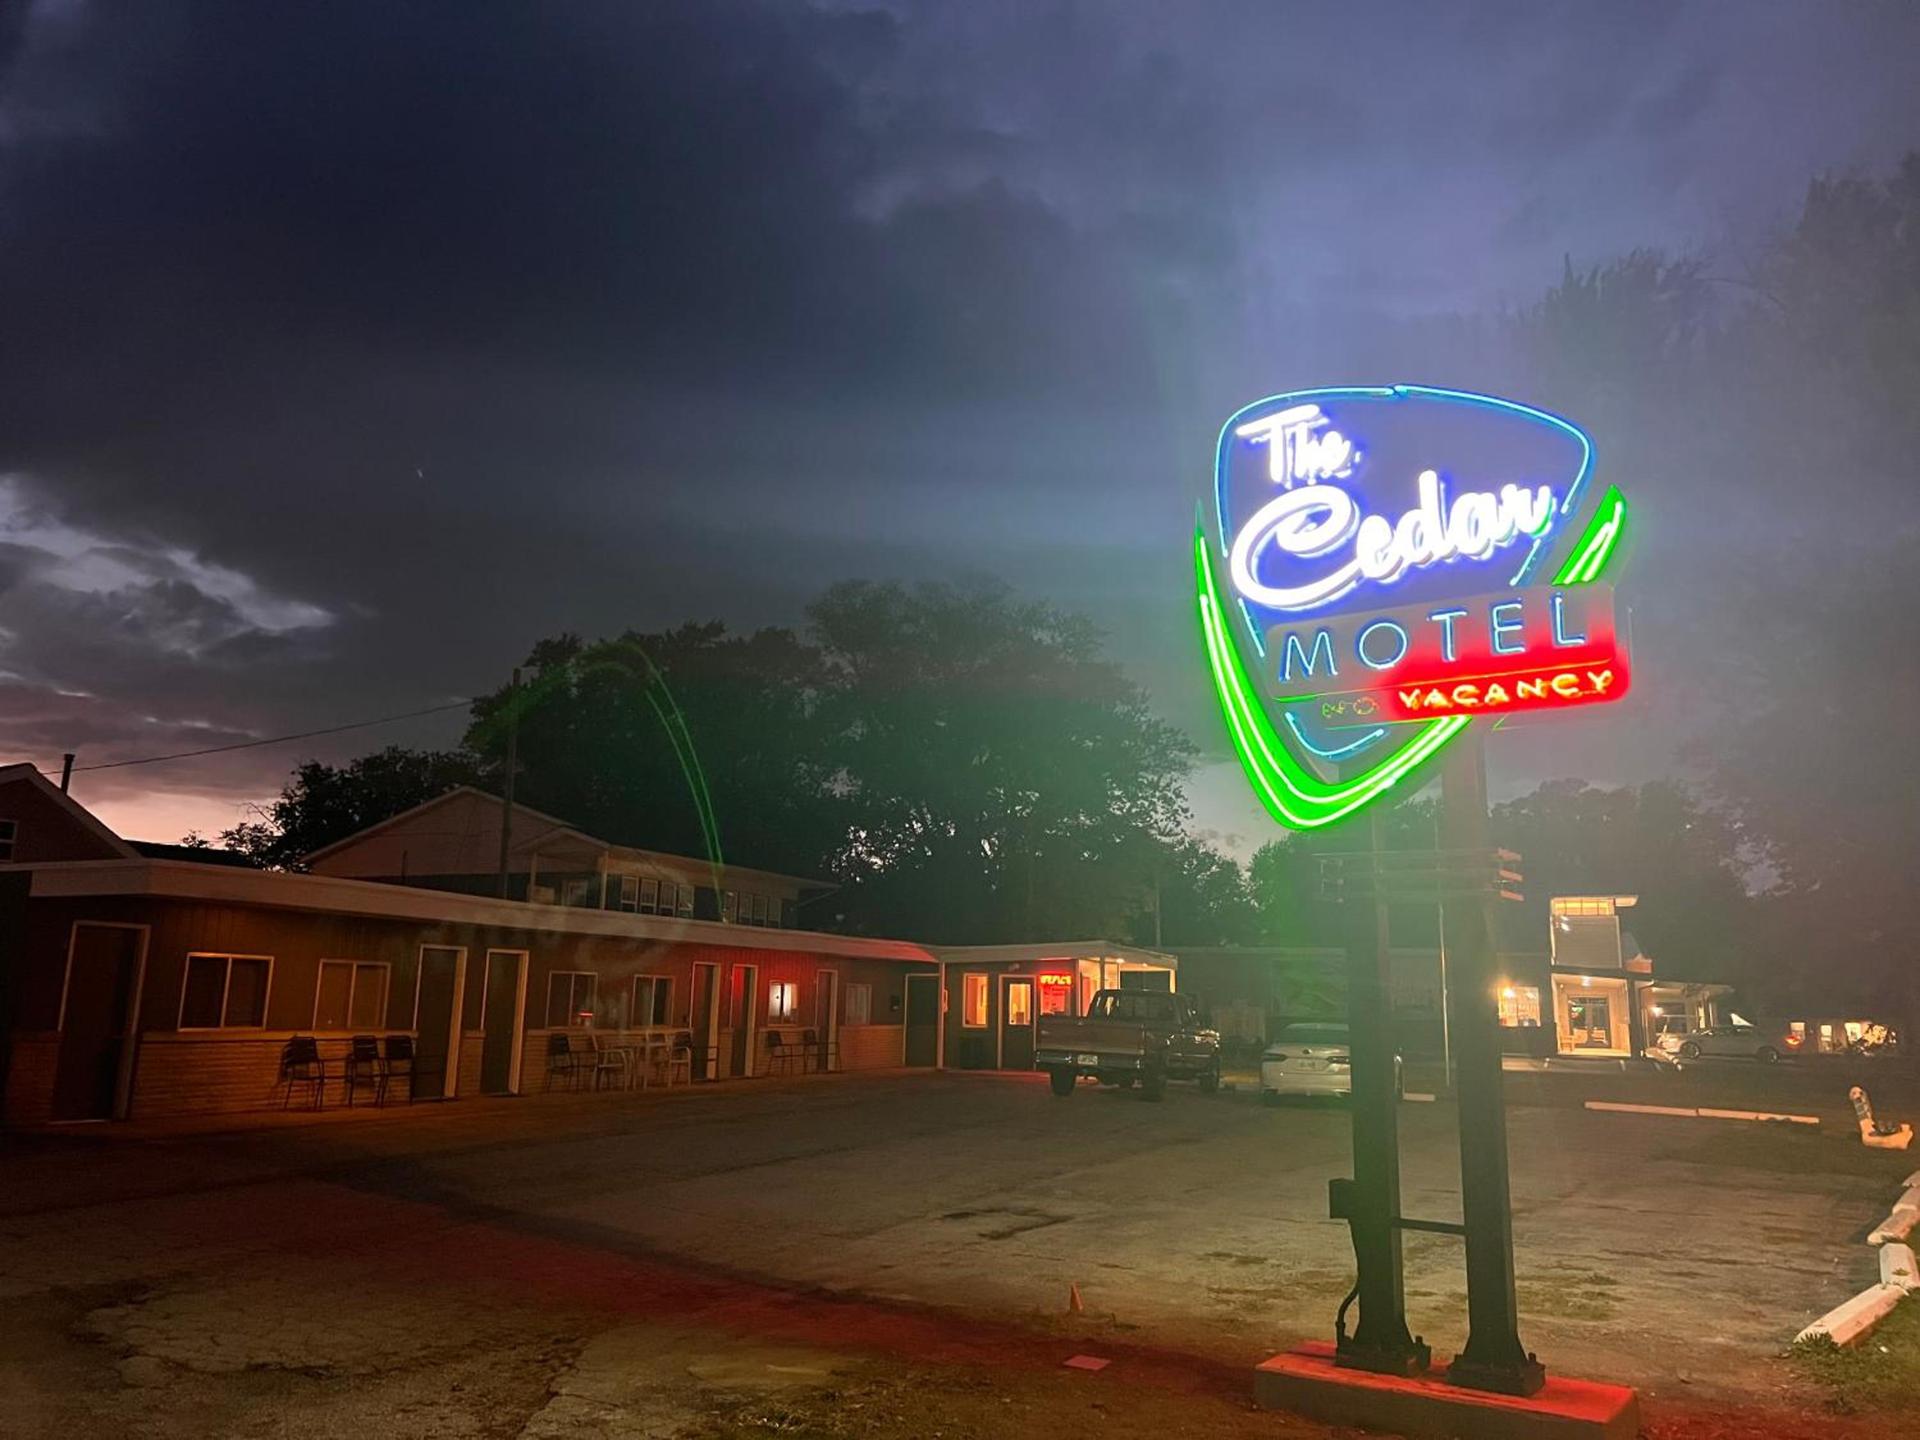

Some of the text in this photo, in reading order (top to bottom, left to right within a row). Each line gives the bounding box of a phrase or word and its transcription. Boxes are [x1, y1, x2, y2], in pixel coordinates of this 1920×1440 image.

[1236, 404, 1354, 489] The
[1231, 470, 1557, 611] Cedar
[1280, 593, 1588, 682] MOTEL
[1398, 669, 1614, 710] VACANCY
